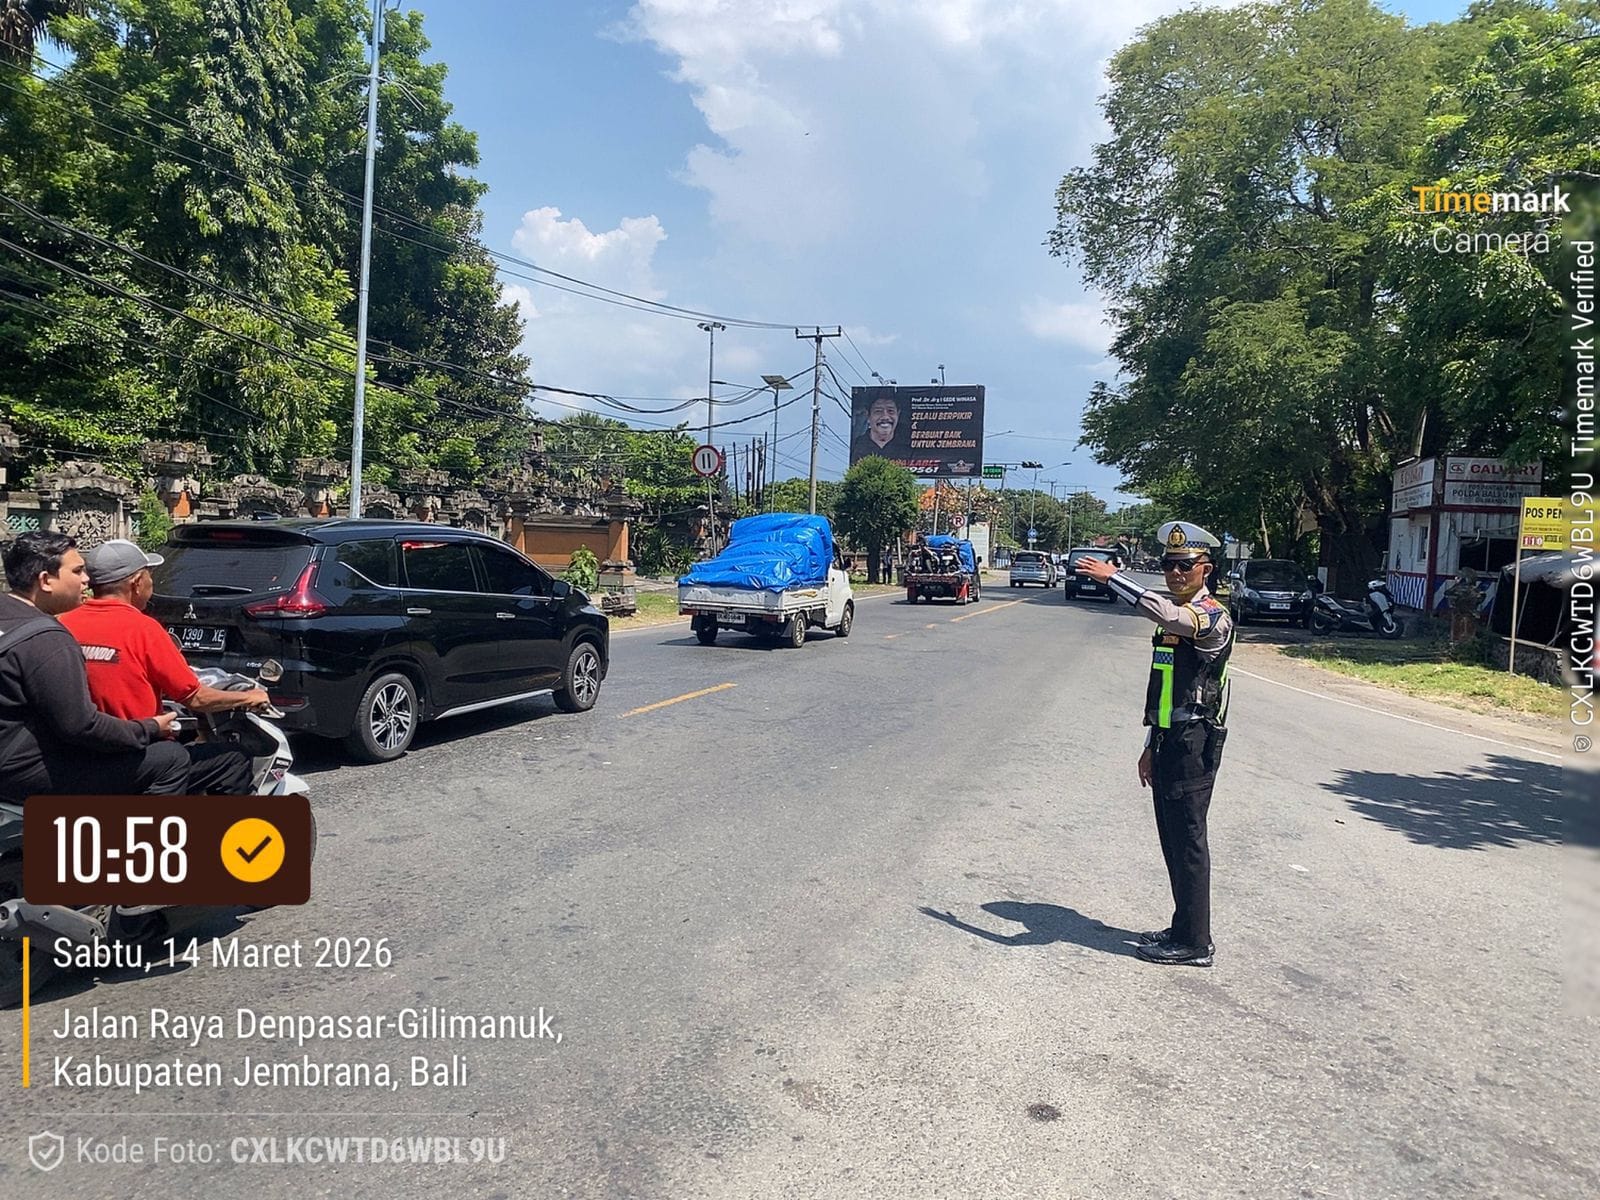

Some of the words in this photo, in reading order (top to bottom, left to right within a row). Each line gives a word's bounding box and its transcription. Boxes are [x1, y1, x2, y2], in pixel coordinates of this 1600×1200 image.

[1470, 464, 1538, 476] CALRY
[1525, 508, 1544, 518] POS
[182, 628, 204, 640] 1390
[212, 630, 225, 642] XE
